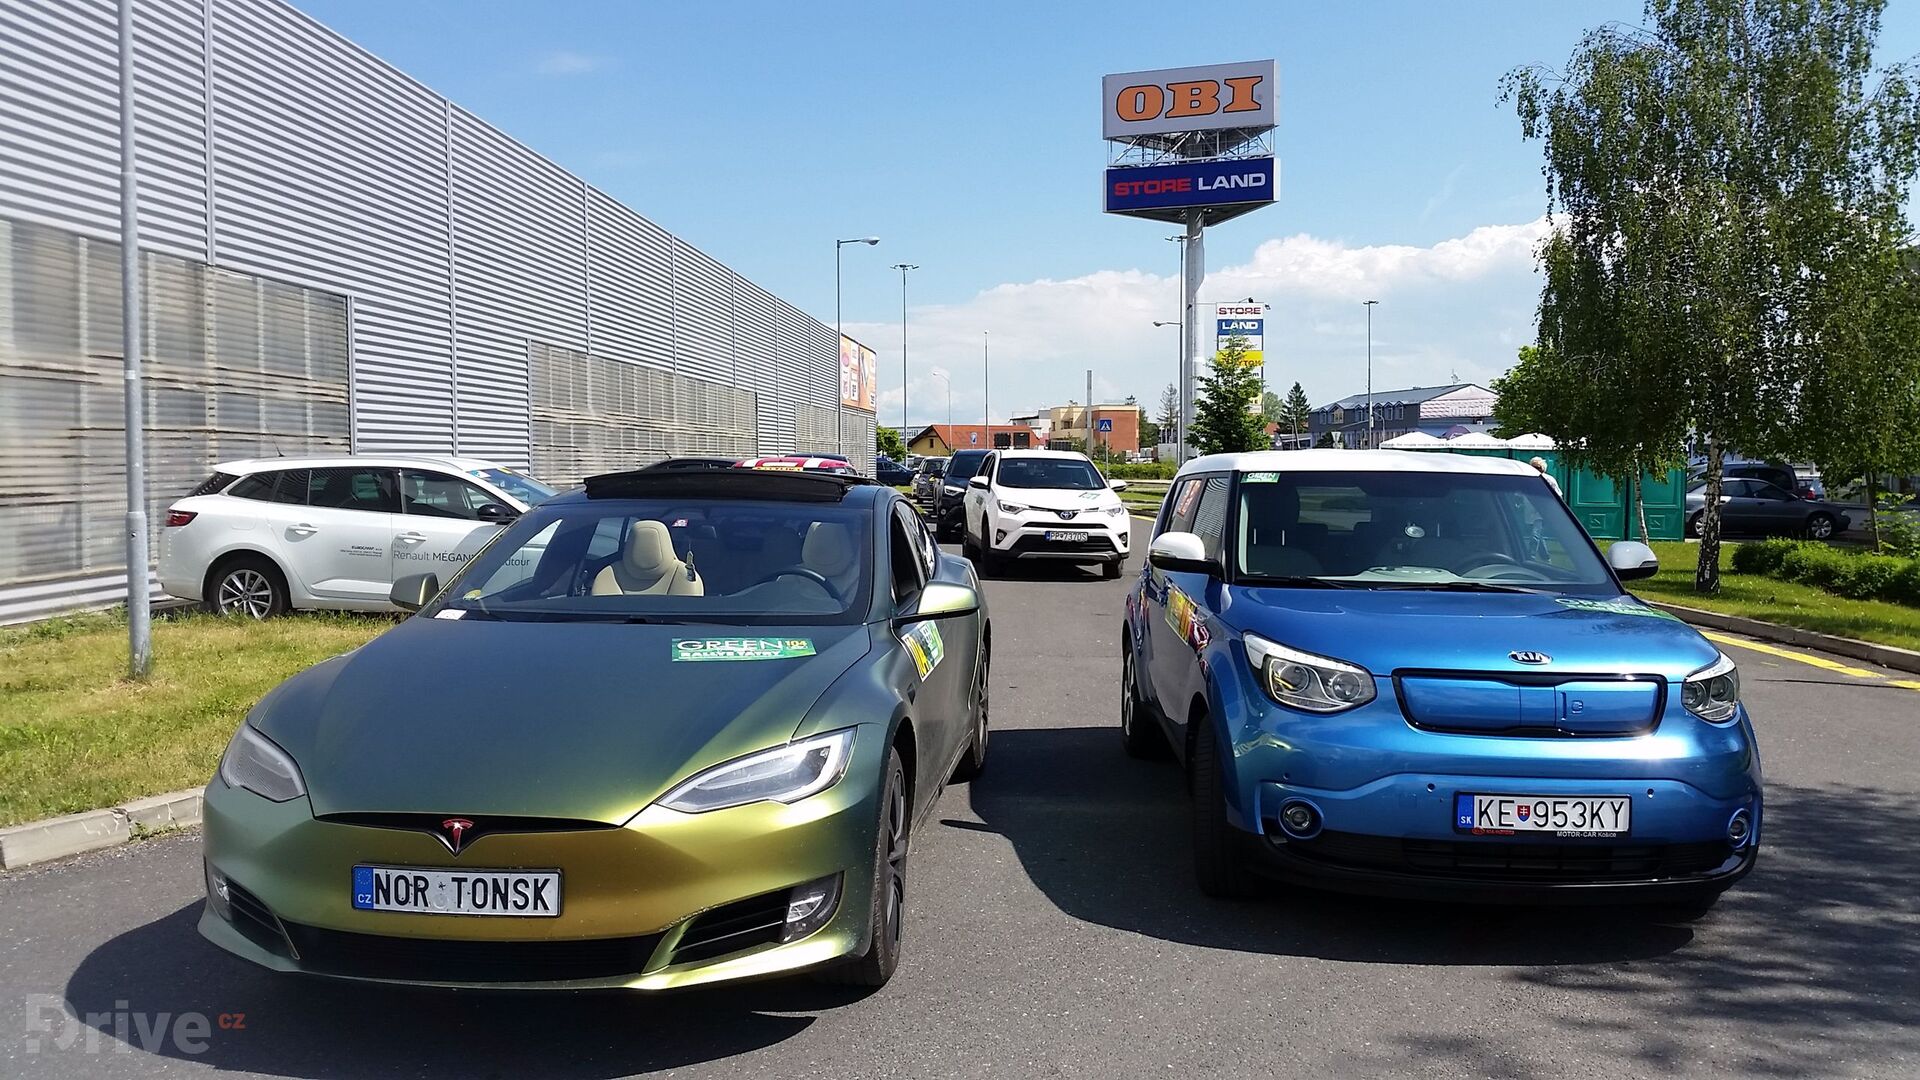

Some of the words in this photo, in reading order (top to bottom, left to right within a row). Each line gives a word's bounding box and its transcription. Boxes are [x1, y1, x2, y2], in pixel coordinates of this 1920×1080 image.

[1116, 76, 1263, 122] OBI
[1114, 177, 1192, 197] STORE
[1198, 173, 1266, 191] LAND
[1218, 307, 1261, 315] STORE
[1222, 321, 1259, 330] LAND
[393, 550, 430, 561] Renault
[432, 550, 476, 563] MÉGAN
[677, 640, 783, 651] GREEN
[1516, 652, 1548, 663] KIA
[1478, 799, 1515, 828] KE
[1533, 801, 1625, 829] 953KY
[1460, 816, 1472, 824] SK
[373, 873, 430, 908] NOR
[451, 877, 551, 911] TONSK
[357, 893, 372, 904] CZ
